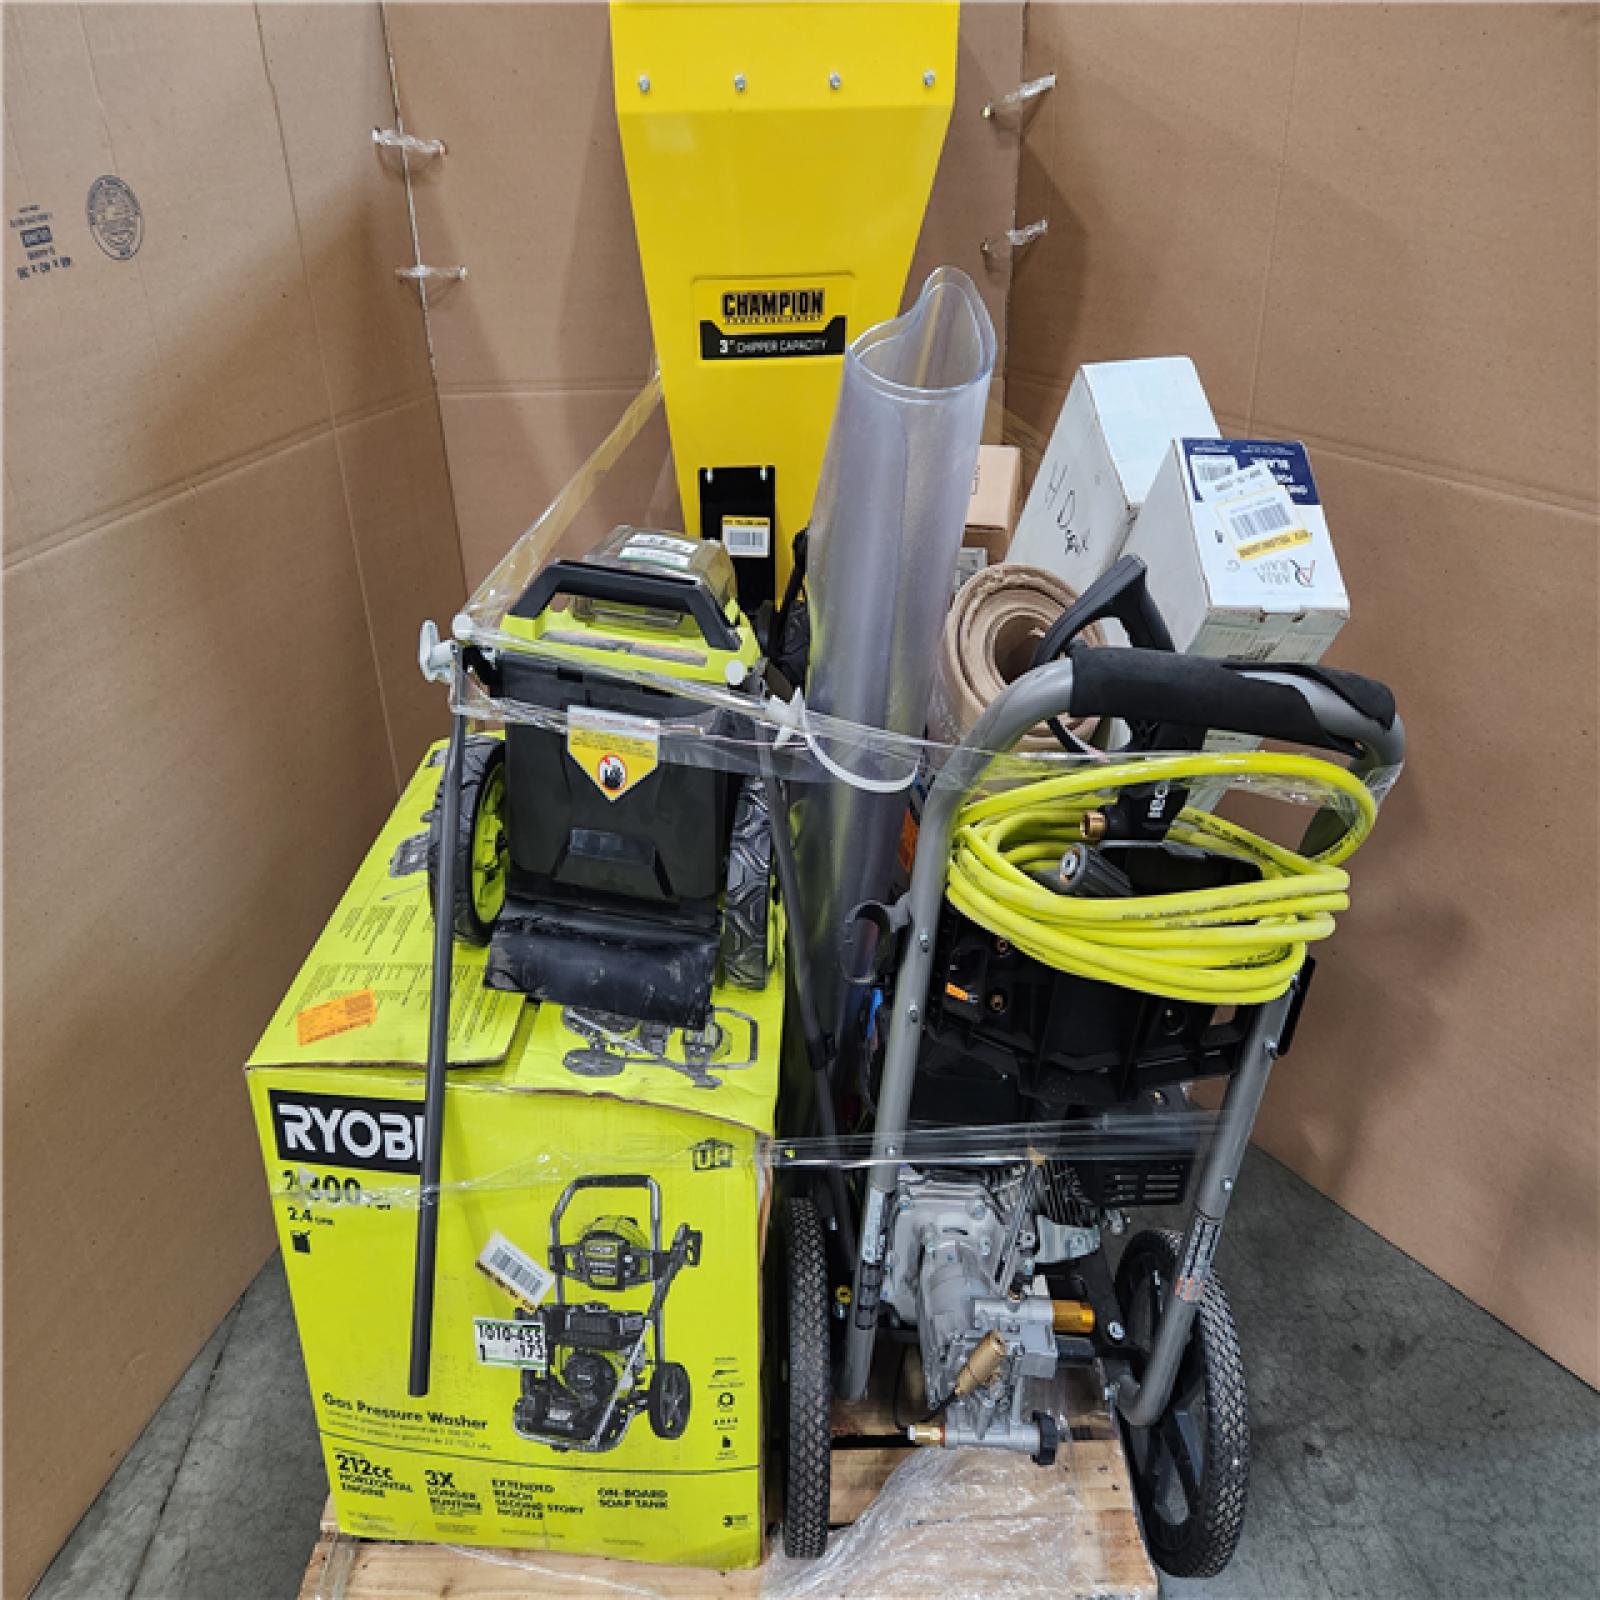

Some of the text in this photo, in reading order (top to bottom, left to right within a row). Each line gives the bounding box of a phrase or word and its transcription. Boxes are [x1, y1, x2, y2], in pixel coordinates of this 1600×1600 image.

[722, 290, 825, 316] CHAMPION
[277, 1103, 425, 1161] RYOBI
[322, 1391, 353, 1411] Gas
[357, 1400, 423, 1423] Pressure
[427, 1410, 488, 1431] Washer
[335, 1454, 394, 1481] 212cc
[339, 1473, 413, 1494] HORIZONTAL
[424, 1469, 456, 1489] 3X
[491, 1479, 556, 1494] EXTENDED
[342, 1483, 386, 1498] ENGINE
[427, 1487, 477, 1501] LONGER
[597, 1487, 668, 1499] ON-BOARD
[599, 1499, 668, 1509] SOAP TANK
